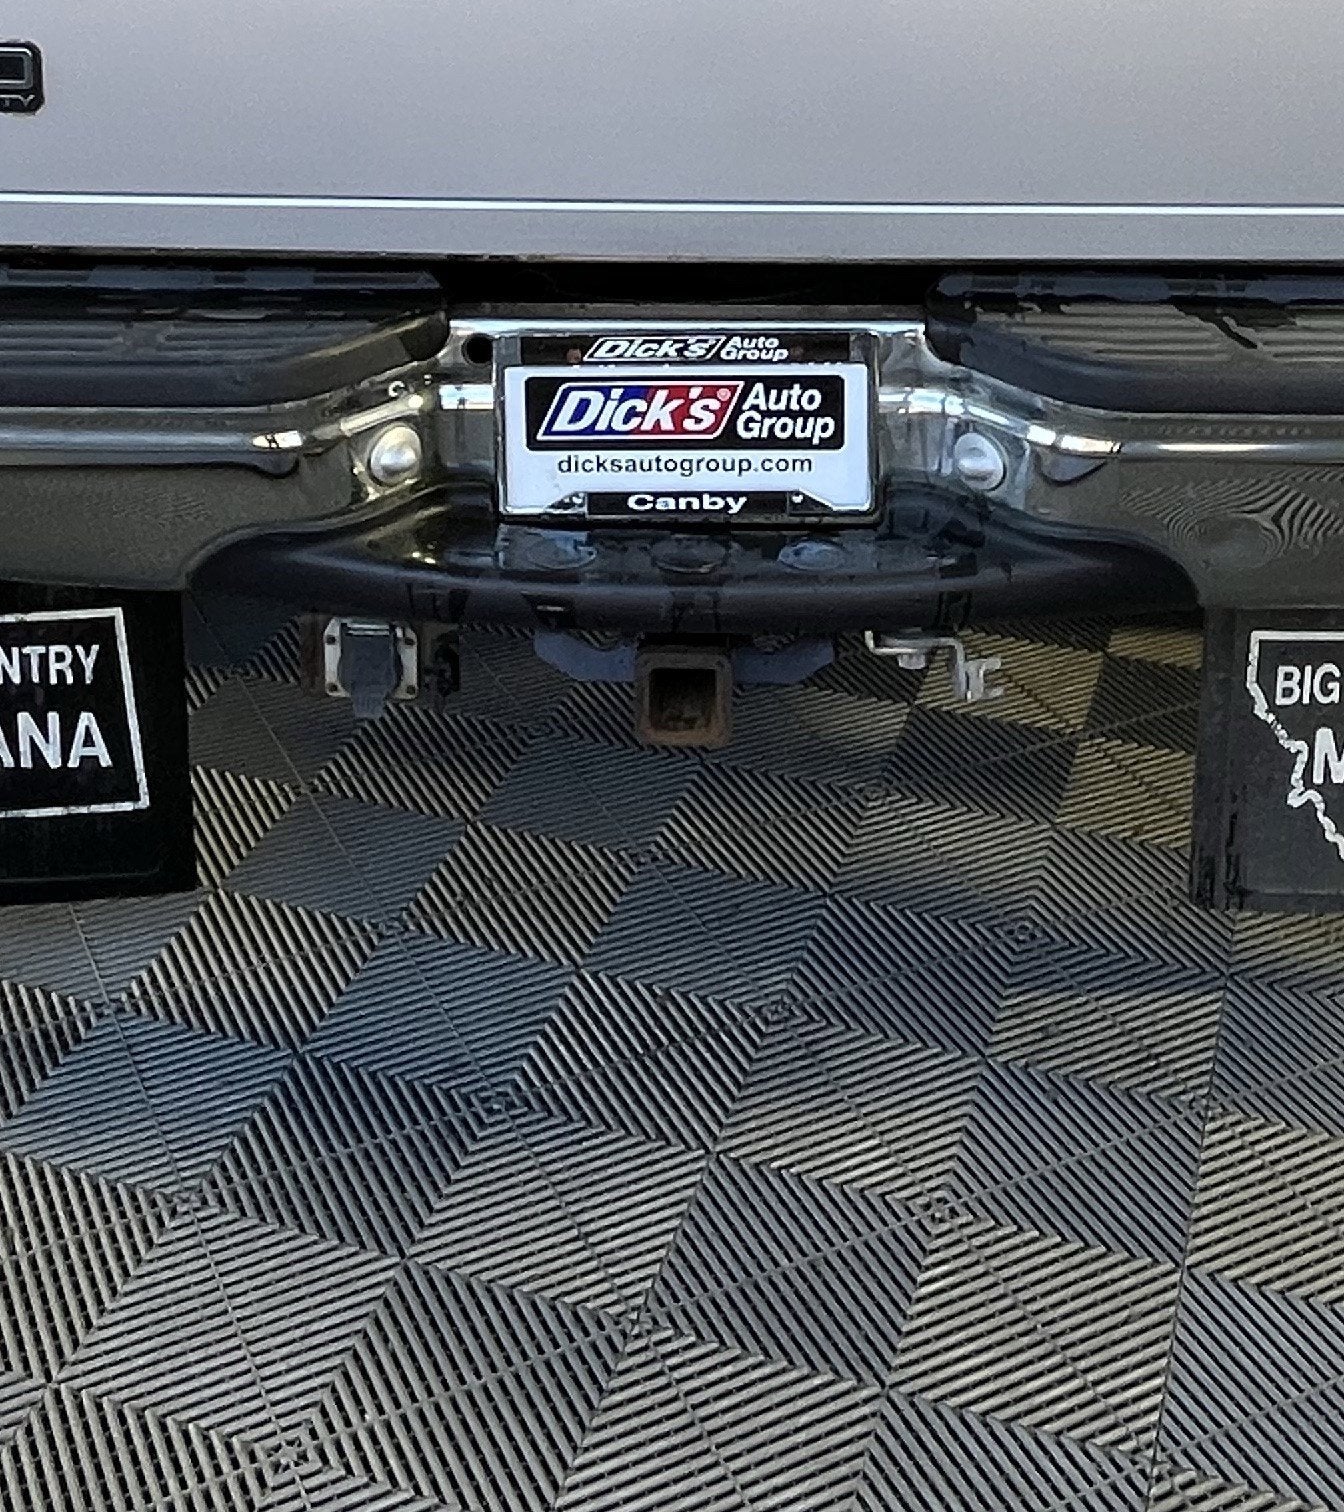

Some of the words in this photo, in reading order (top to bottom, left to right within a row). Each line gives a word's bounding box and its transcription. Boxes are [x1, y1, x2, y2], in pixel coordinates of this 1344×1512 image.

[592, 337, 710, 359] Dick's
[722, 336, 779, 349] Auto
[720, 346, 789, 362] Group
[550, 386, 722, 434] Dick's
[741, 382, 823, 412] Auto
[736, 411, 835, 445] Group
[557, 454, 813, 477] dicksautogroup.com
[627, 493, 748, 514] Canby
[1274, 663, 1342, 706] BIG
